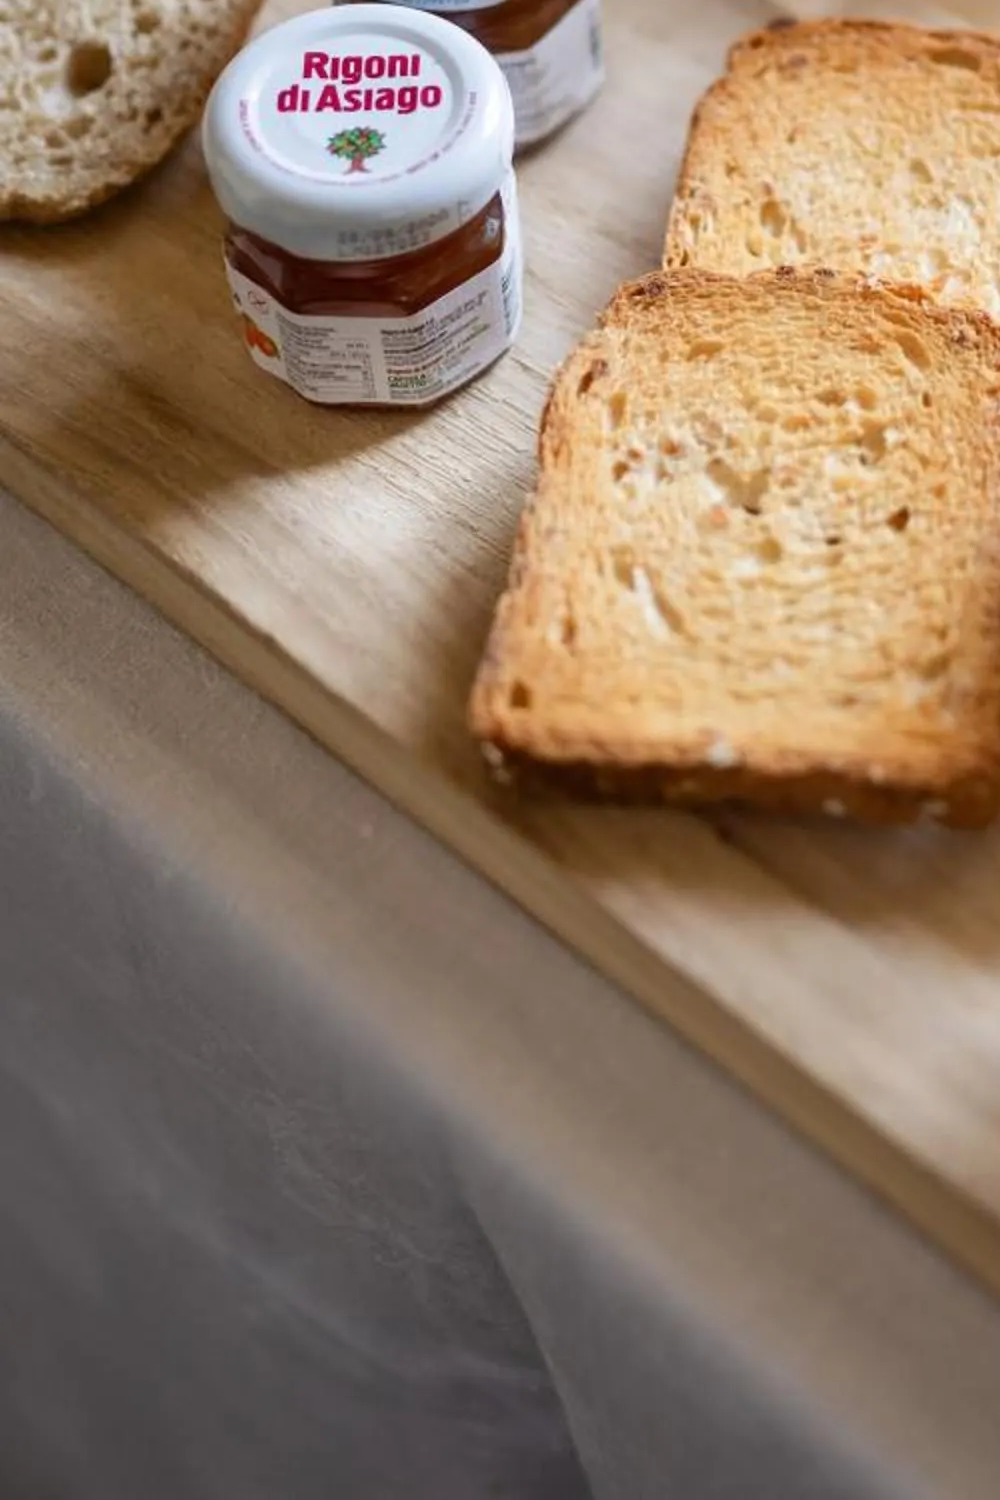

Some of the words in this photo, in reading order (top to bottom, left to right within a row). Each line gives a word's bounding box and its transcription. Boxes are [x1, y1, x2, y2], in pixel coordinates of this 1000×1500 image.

[303, 51, 421, 85] Rigoni
[276, 84, 310, 113] di
[315, 84, 442, 115] Asiago
